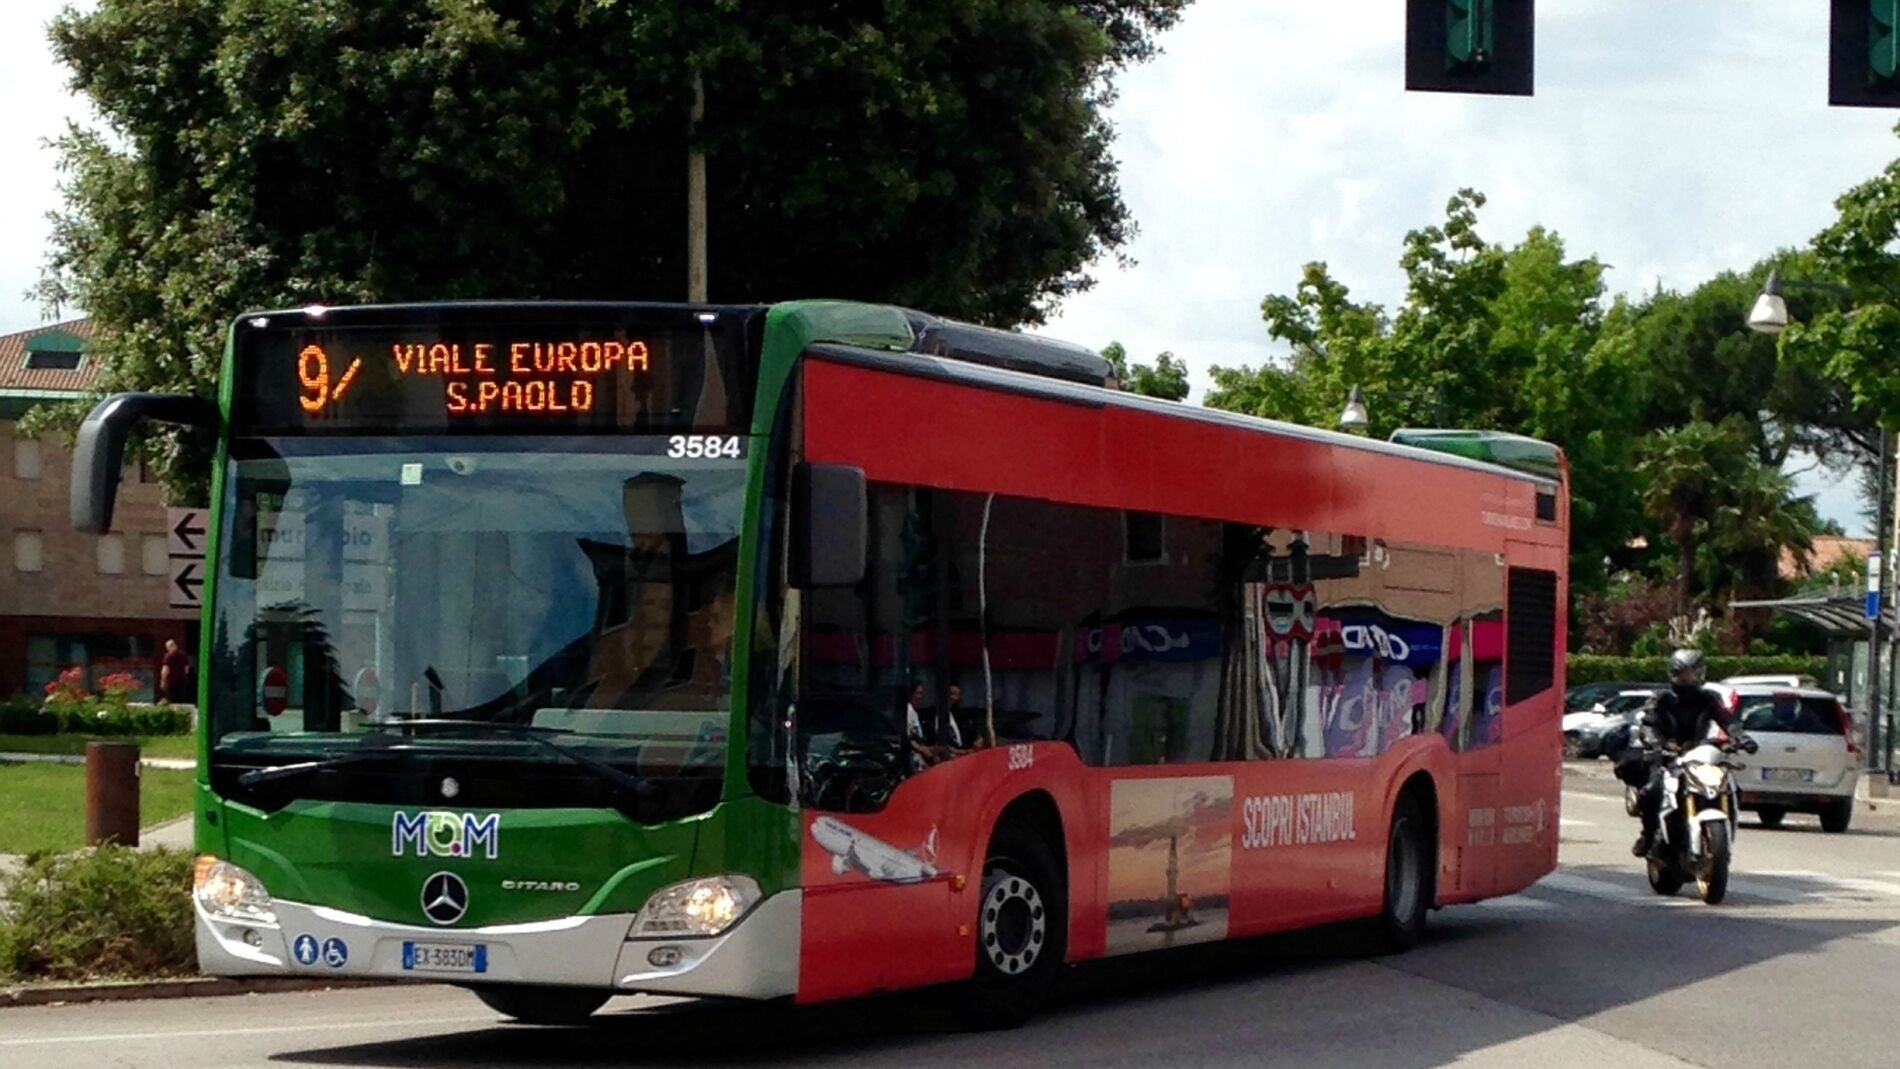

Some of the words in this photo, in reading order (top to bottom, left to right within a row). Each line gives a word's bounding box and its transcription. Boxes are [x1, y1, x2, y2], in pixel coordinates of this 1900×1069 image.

[393, 343, 496, 373] VIALE
[511, 341, 649, 372] EUROPA
[446, 380, 594, 411] S.PAOLO
[667, 436, 741, 459] 3584
[1242, 795, 1293, 849] SCOPRI
[1296, 791, 1357, 845] ISTANBUL
[501, 880, 580, 891] CITARO
